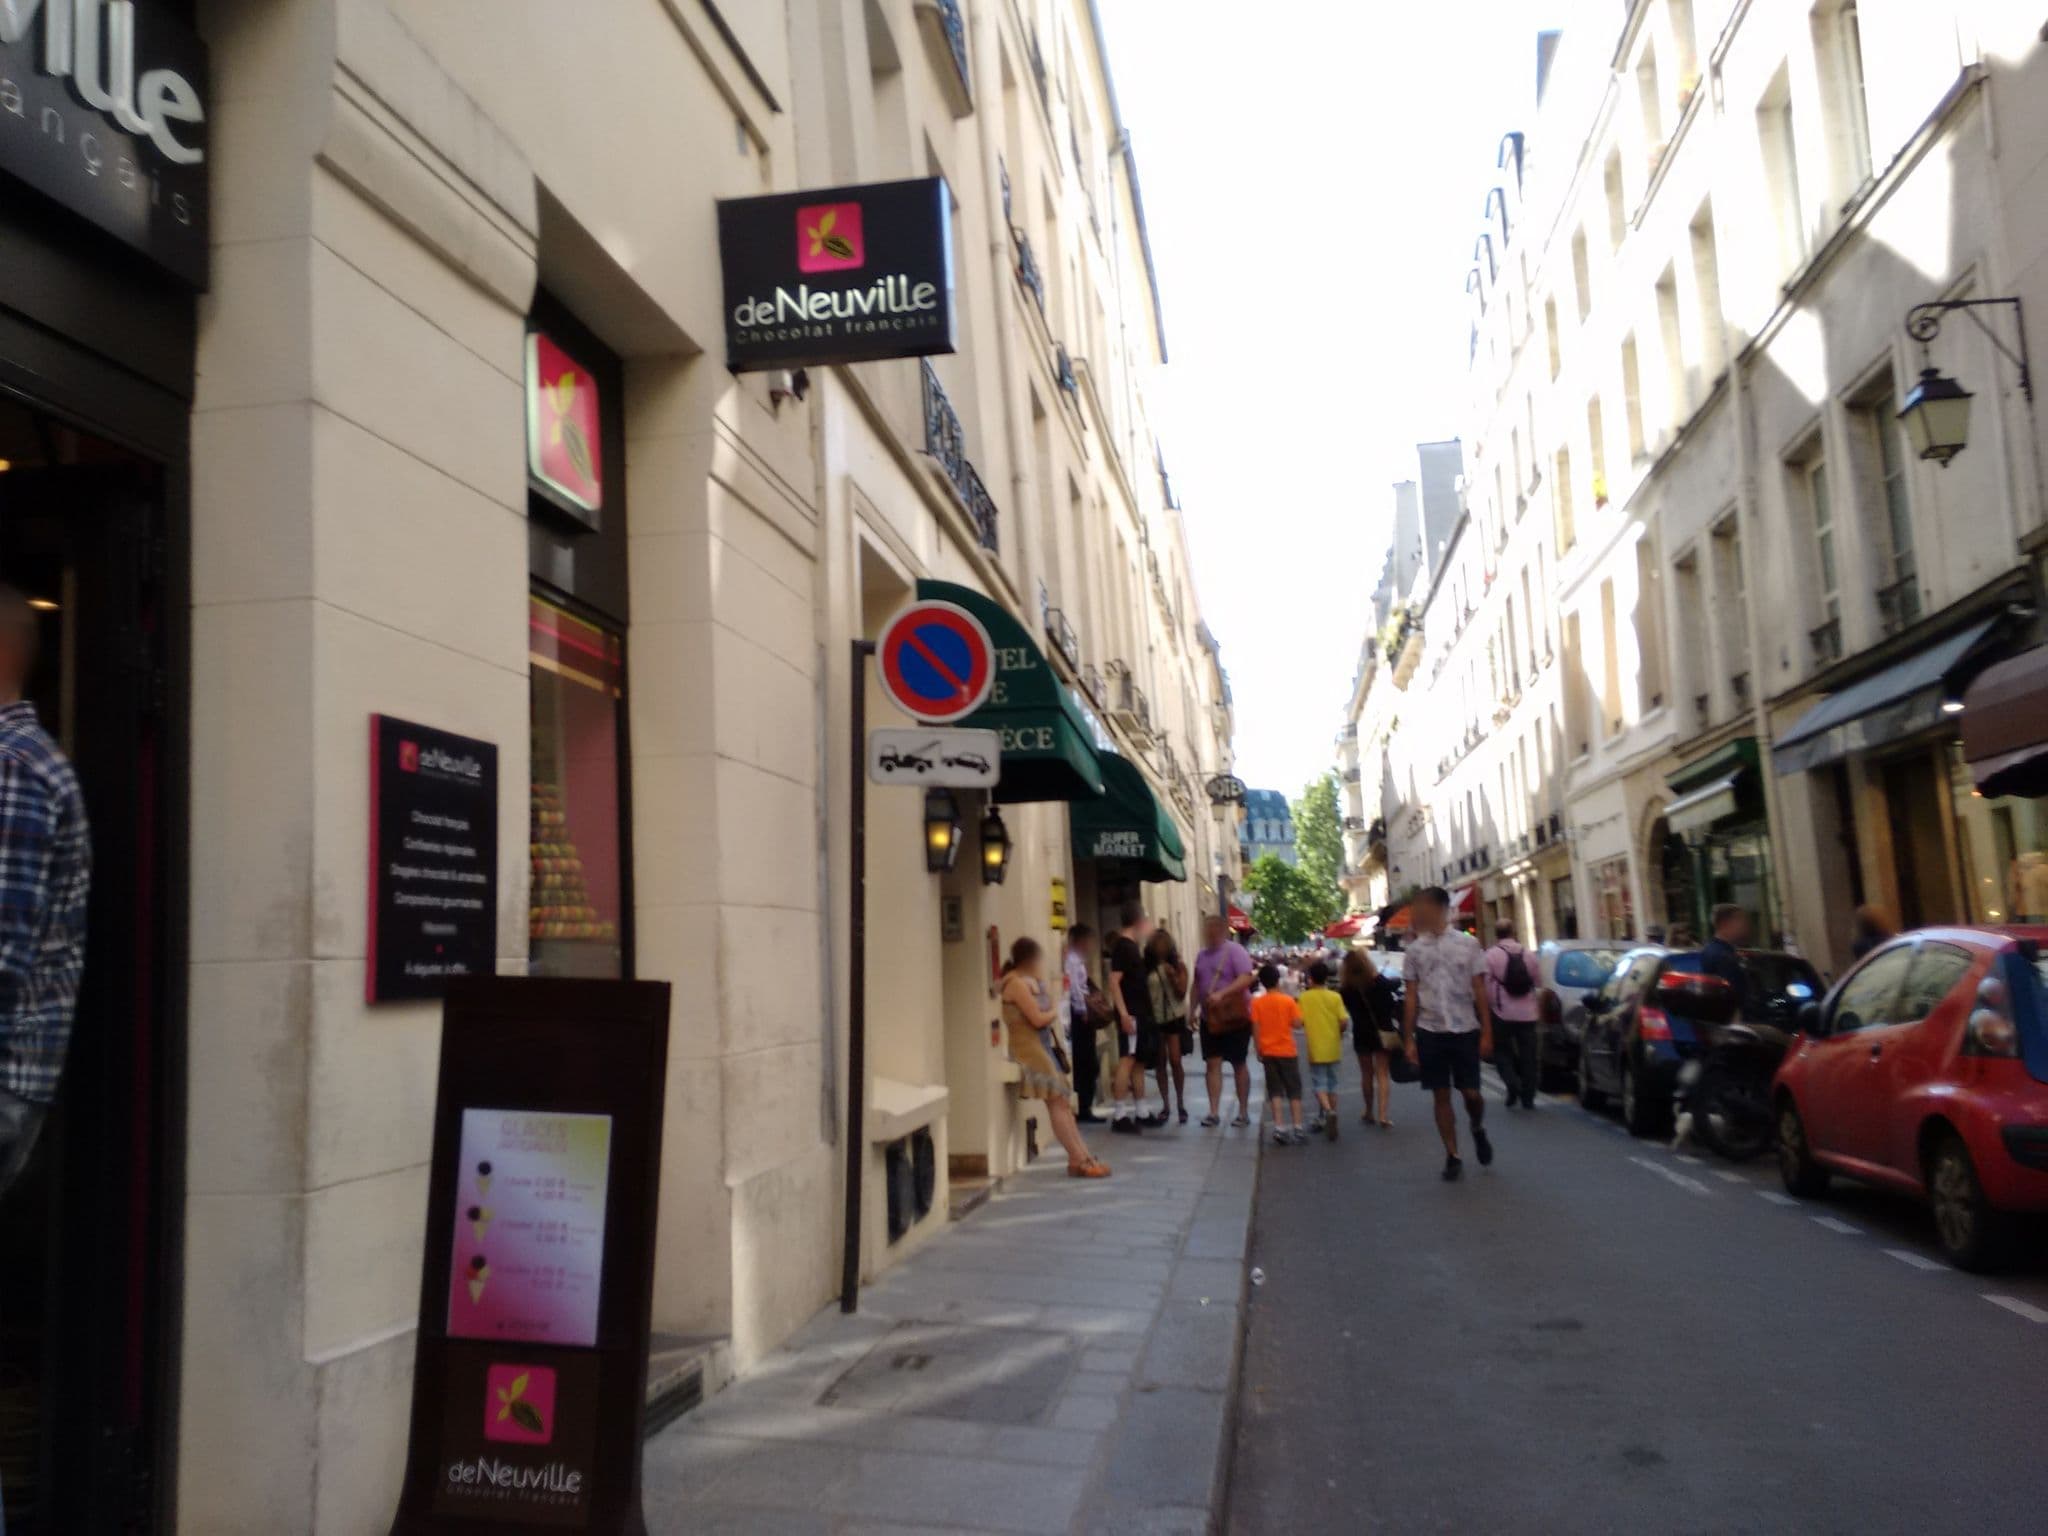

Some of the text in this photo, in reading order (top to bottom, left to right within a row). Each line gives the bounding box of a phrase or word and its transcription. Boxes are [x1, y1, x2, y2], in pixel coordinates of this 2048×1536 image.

[734, 273, 937, 328] deNeuville
[996, 648, 1036, 671] EL
[1093, 843, 1146, 857] MARKET
[448, 1456, 582, 1494] deNeuville
